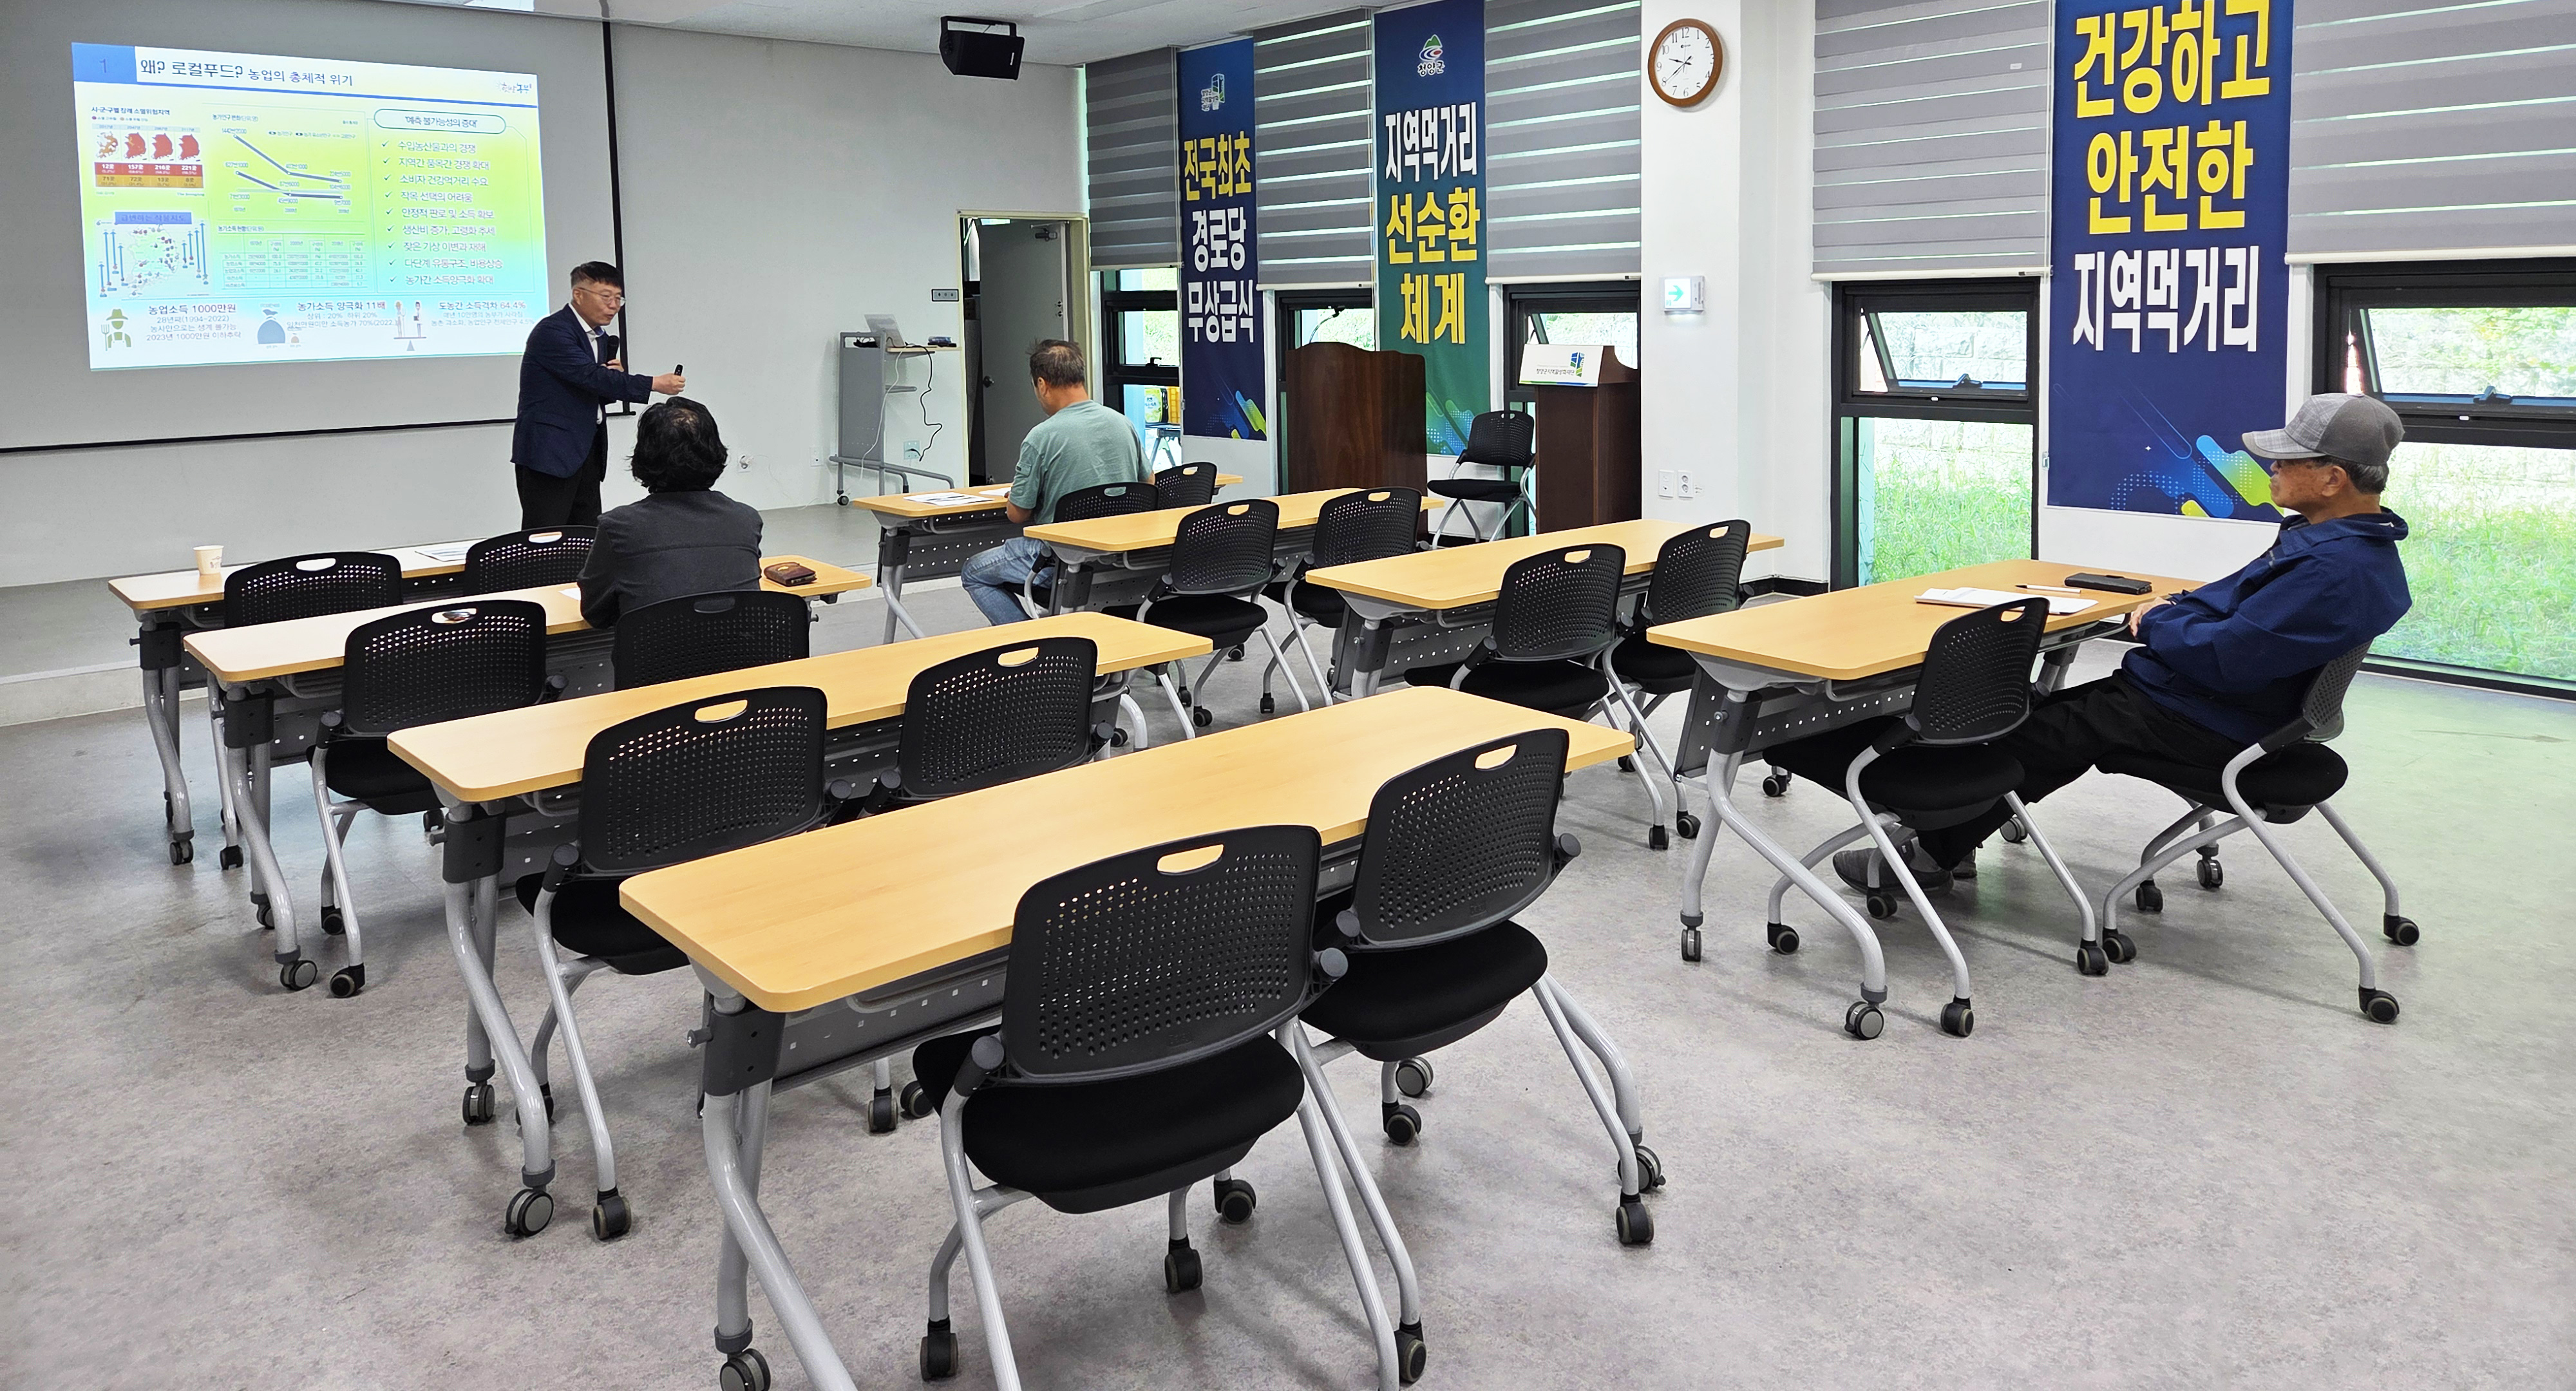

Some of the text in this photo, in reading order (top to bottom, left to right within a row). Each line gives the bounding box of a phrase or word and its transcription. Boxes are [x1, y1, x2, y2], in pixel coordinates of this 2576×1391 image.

[1672, 33, 1678, 43] 11
[1681, 27, 1690, 39] 12
[1662, 44, 1669, 55] 10
[2074, 0, 2270, 118] 건강하고
[1656, 62, 1662, 71] 9
[140, 60, 353, 86] 왜? 로컬푸드? 농업의 총체적 위기
[1662, 77, 1667, 87] 8
[1672, 86, 1677, 95] 7
[1683, 88, 1689, 97] 6
[397, 141, 476, 154] 수입농산물과의 경쟁
[1385, 102, 1477, 183] 지역먹거리
[399, 157, 425, 168] 지역간
[455, 160, 471, 170] 경쟁
[1184, 131, 1252, 202] 전국최초
[399, 175, 426, 185] 소비자
[471, 177, 488, 187] 수요
[2087, 120, 2253, 235] 안전한
[401, 208, 428, 219] 안정적
[430, 209, 446, 219] 판로
[459, 209, 475, 220] 소득
[402, 225, 428, 236] 생산비
[452, 225, 477, 236] 고령화
[1386, 187, 1480, 265] 선순환
[1192, 206, 1246, 272] 경로당
[422, 242, 440, 252] 기상
[404, 259, 430, 269] 다단계
[406, 275, 431, 285] 농가간
[2073, 245, 2259, 353] 지역먹거리
[148, 303, 236, 315] 농업소득 1000만원
[298, 302, 334, 312] 농가소득
[337, 302, 363, 311] 양극화
[439, 302, 462, 310] 도농간
[467, 301, 498, 310] 소득격차
[1188, 279, 1254, 343] 무상급식
[1401, 272, 1466, 345] 체계
